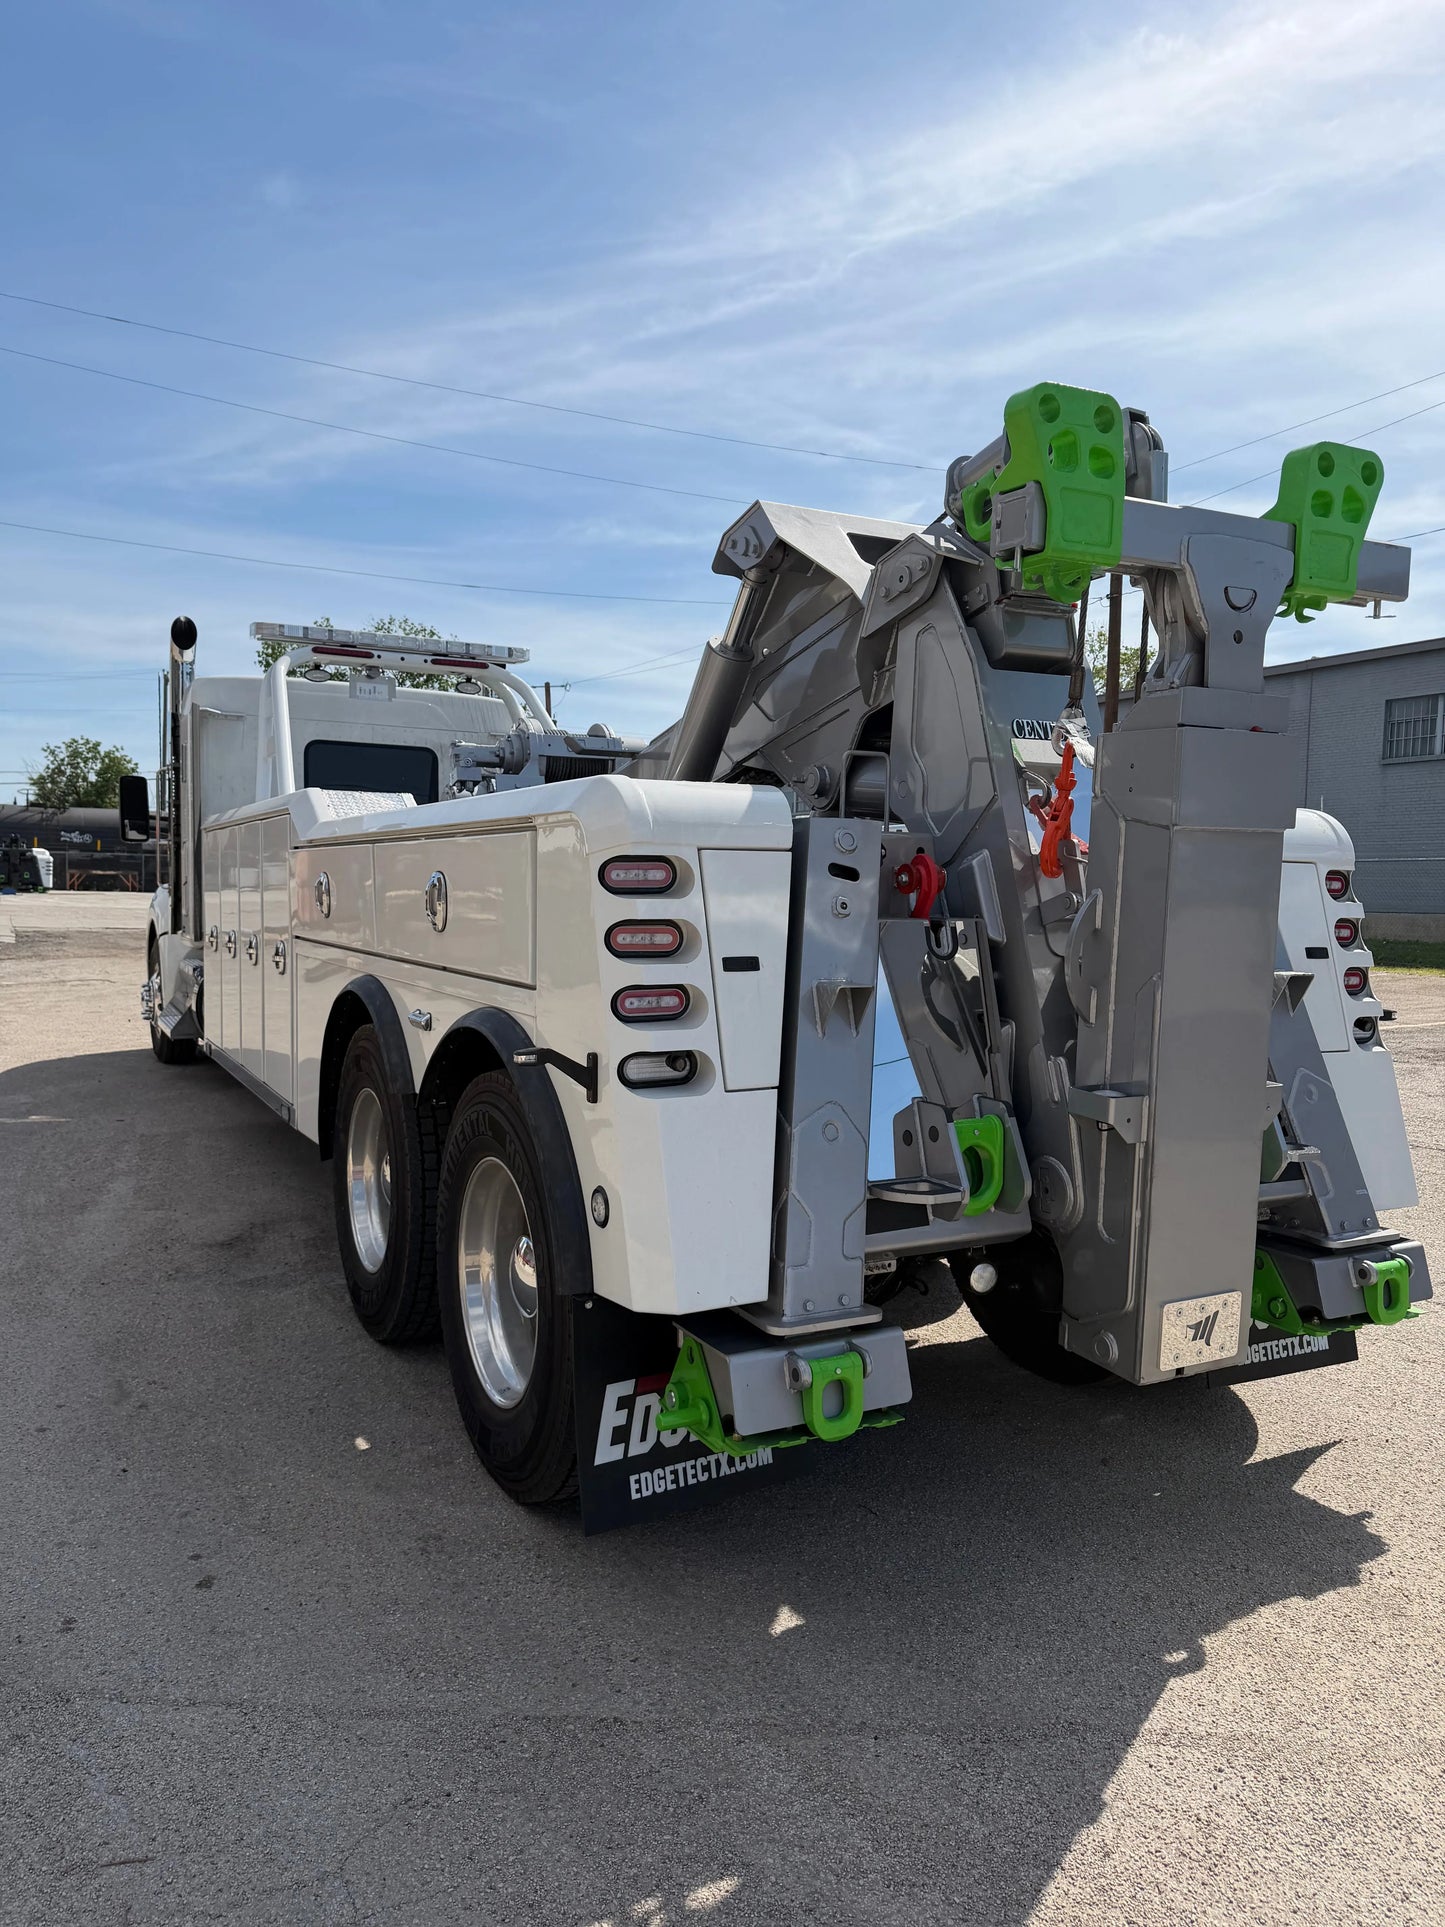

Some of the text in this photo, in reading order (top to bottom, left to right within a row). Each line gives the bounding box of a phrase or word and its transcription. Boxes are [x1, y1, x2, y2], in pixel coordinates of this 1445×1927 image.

[1012, 718, 1056, 740] CENT
[1240, 1334, 1329, 1366] DGETECTX.COM
[594, 1378, 700, 1466] ED
[629, 1447, 773, 1500] EDGETECTX.COM
